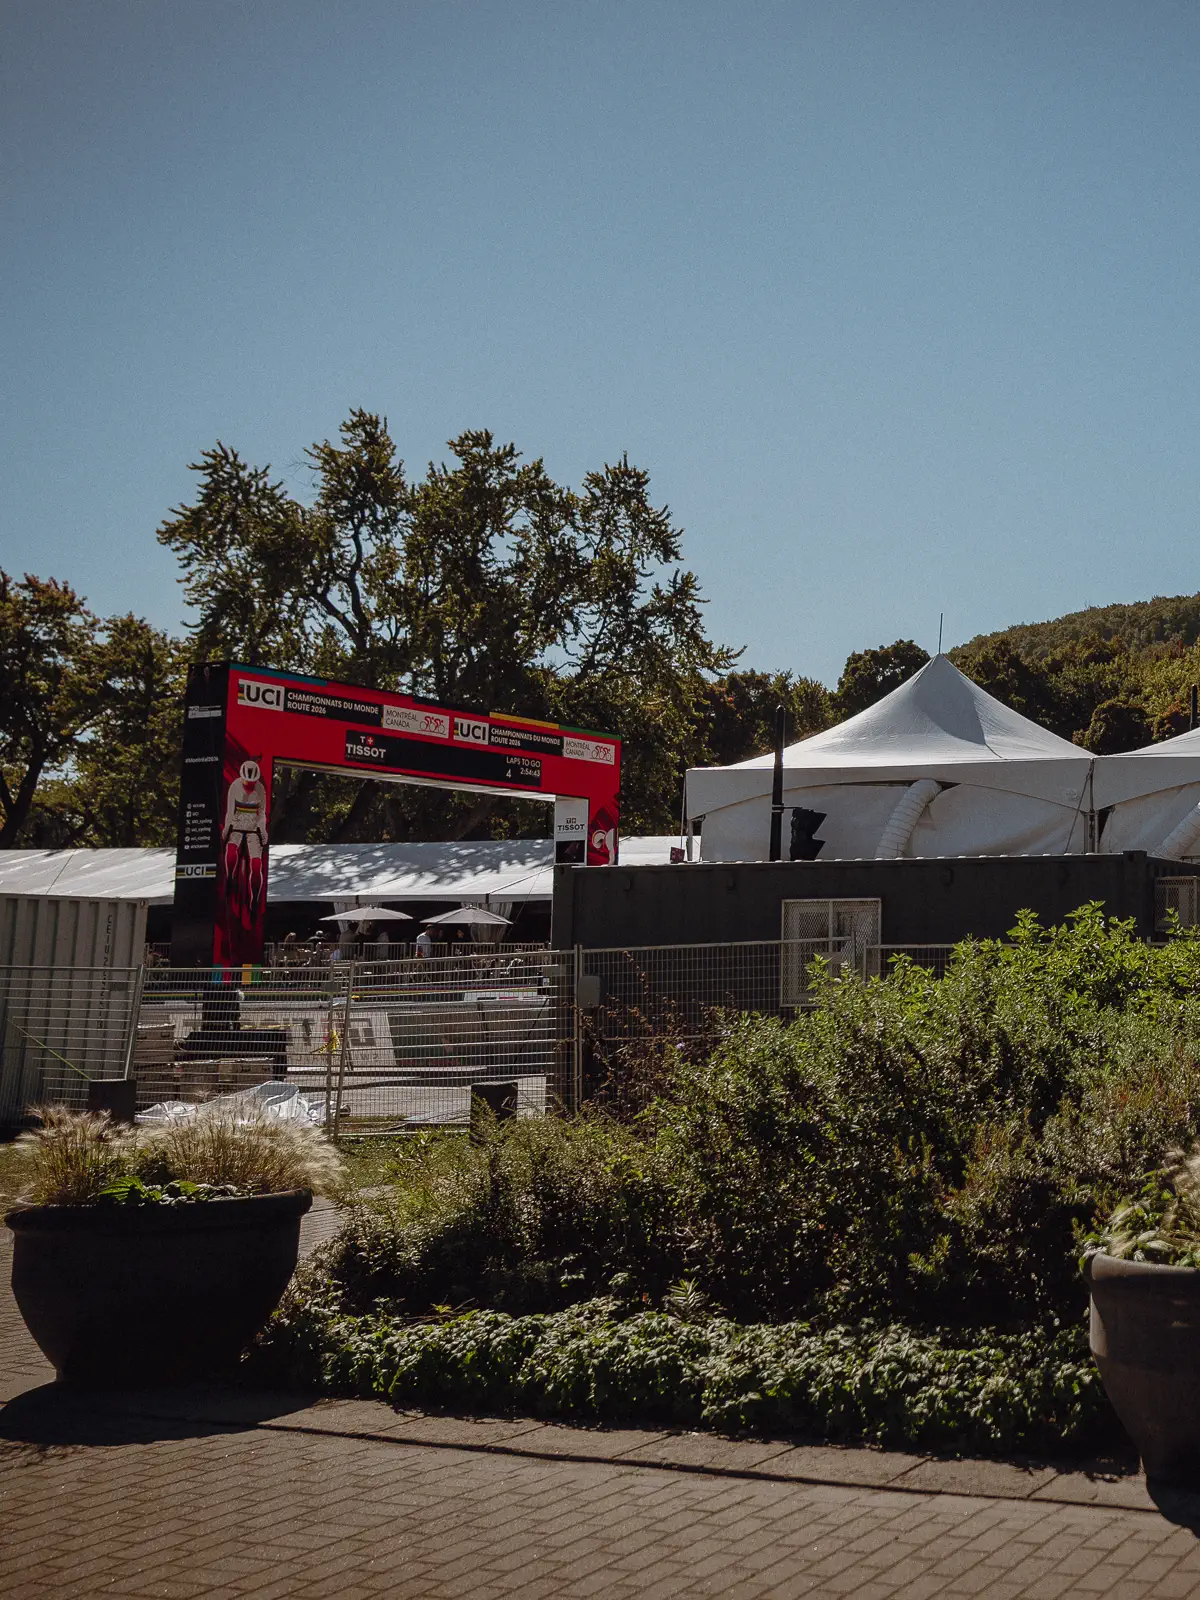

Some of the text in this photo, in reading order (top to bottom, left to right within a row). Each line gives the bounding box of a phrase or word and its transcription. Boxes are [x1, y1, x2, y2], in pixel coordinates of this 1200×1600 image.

[246, 685, 281, 706] UCI
[287, 692, 379, 715] CHAMPIONNATS DU MONDE
[287, 701, 327, 715] ROUTE 2026
[386, 708, 418, 722] MONTRÉAL
[385, 717, 411, 729] CANADA
[460, 723, 486, 741] UCI
[491, 728, 561, 746] CHAMPIONNATS DU MONDE
[491, 736, 520, 747] ROUTE 2026
[566, 740, 590, 751] MONTRÉAL
[346, 744, 386, 758] TISSOT
[565, 748, 585, 757] CANADA
[506, 756, 541, 768] LAPS TO GO
[505, 768, 512, 778] 4
[520, 767, 541, 777] 2:54:43
[185, 866, 205, 876] UCI
